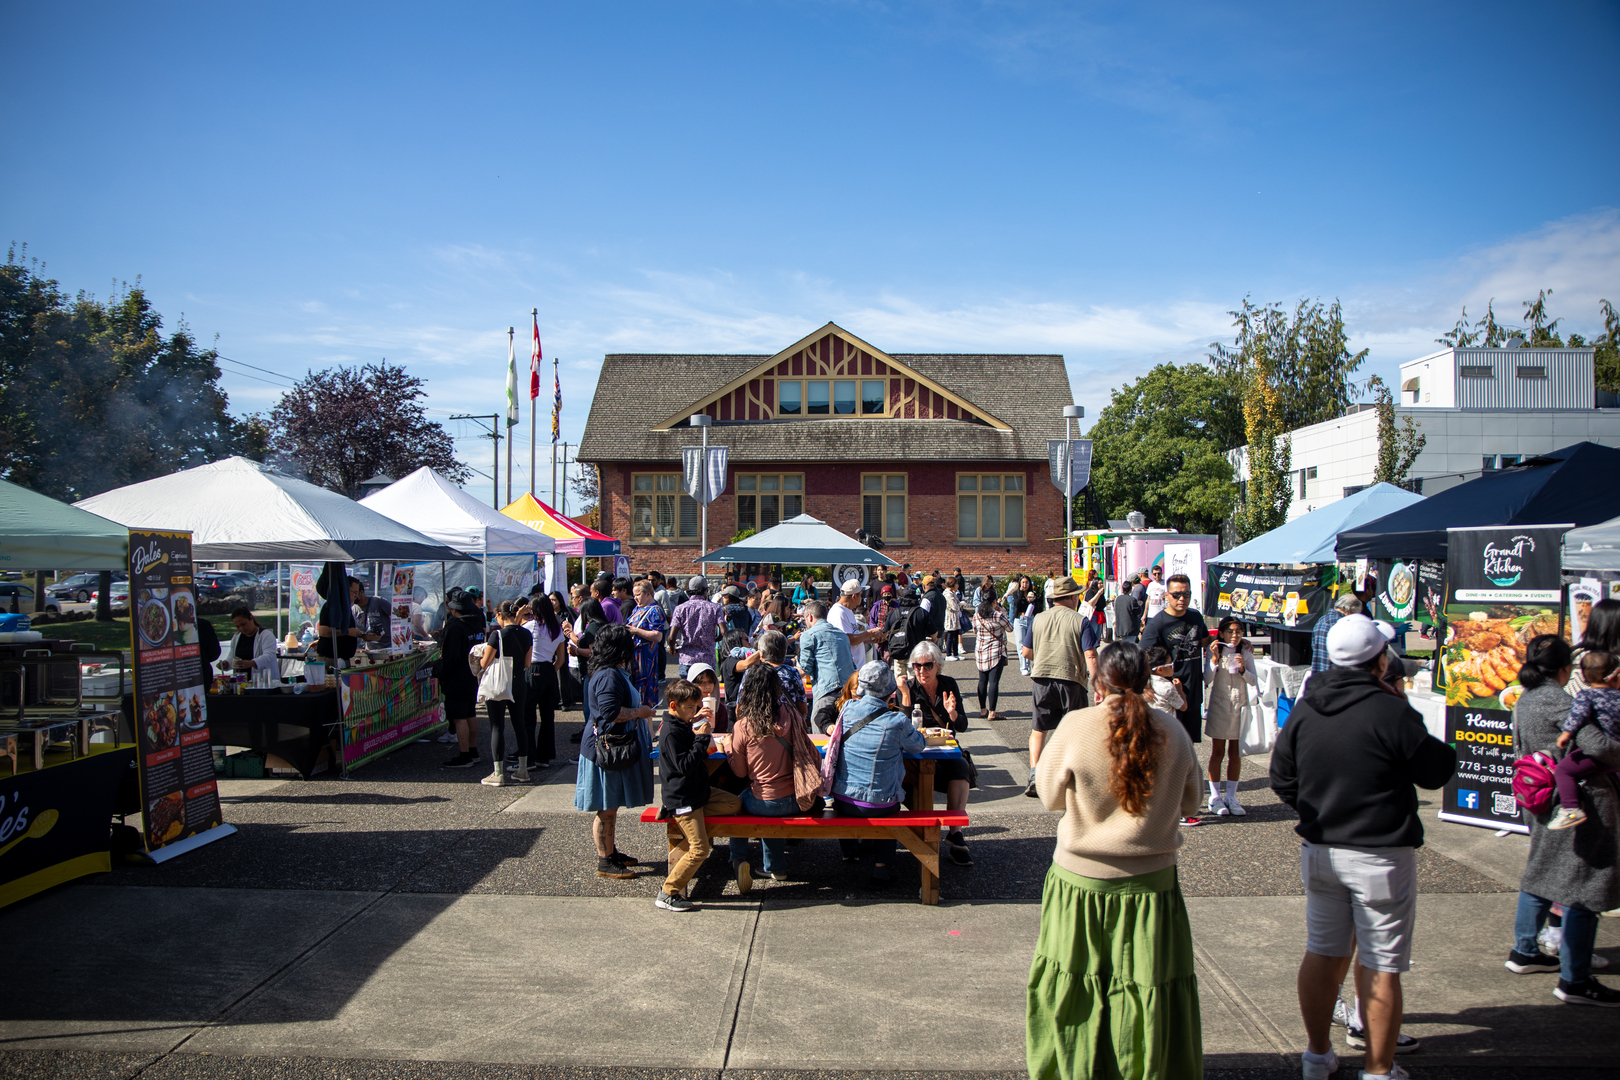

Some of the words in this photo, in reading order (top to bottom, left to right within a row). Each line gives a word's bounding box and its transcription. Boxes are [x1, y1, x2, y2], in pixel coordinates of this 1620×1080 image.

[131, 540, 162, 575] Dale's
[1484, 540, 1528, 560] Grandt
[1484, 557, 1524, 575] Kitchen
[1217, 600, 1231, 611] $15
[1465, 713, 1508, 730] Home
[1455, 730, 1513, 746] BOODLE
[1459, 760, 1513, 775] 778-395
